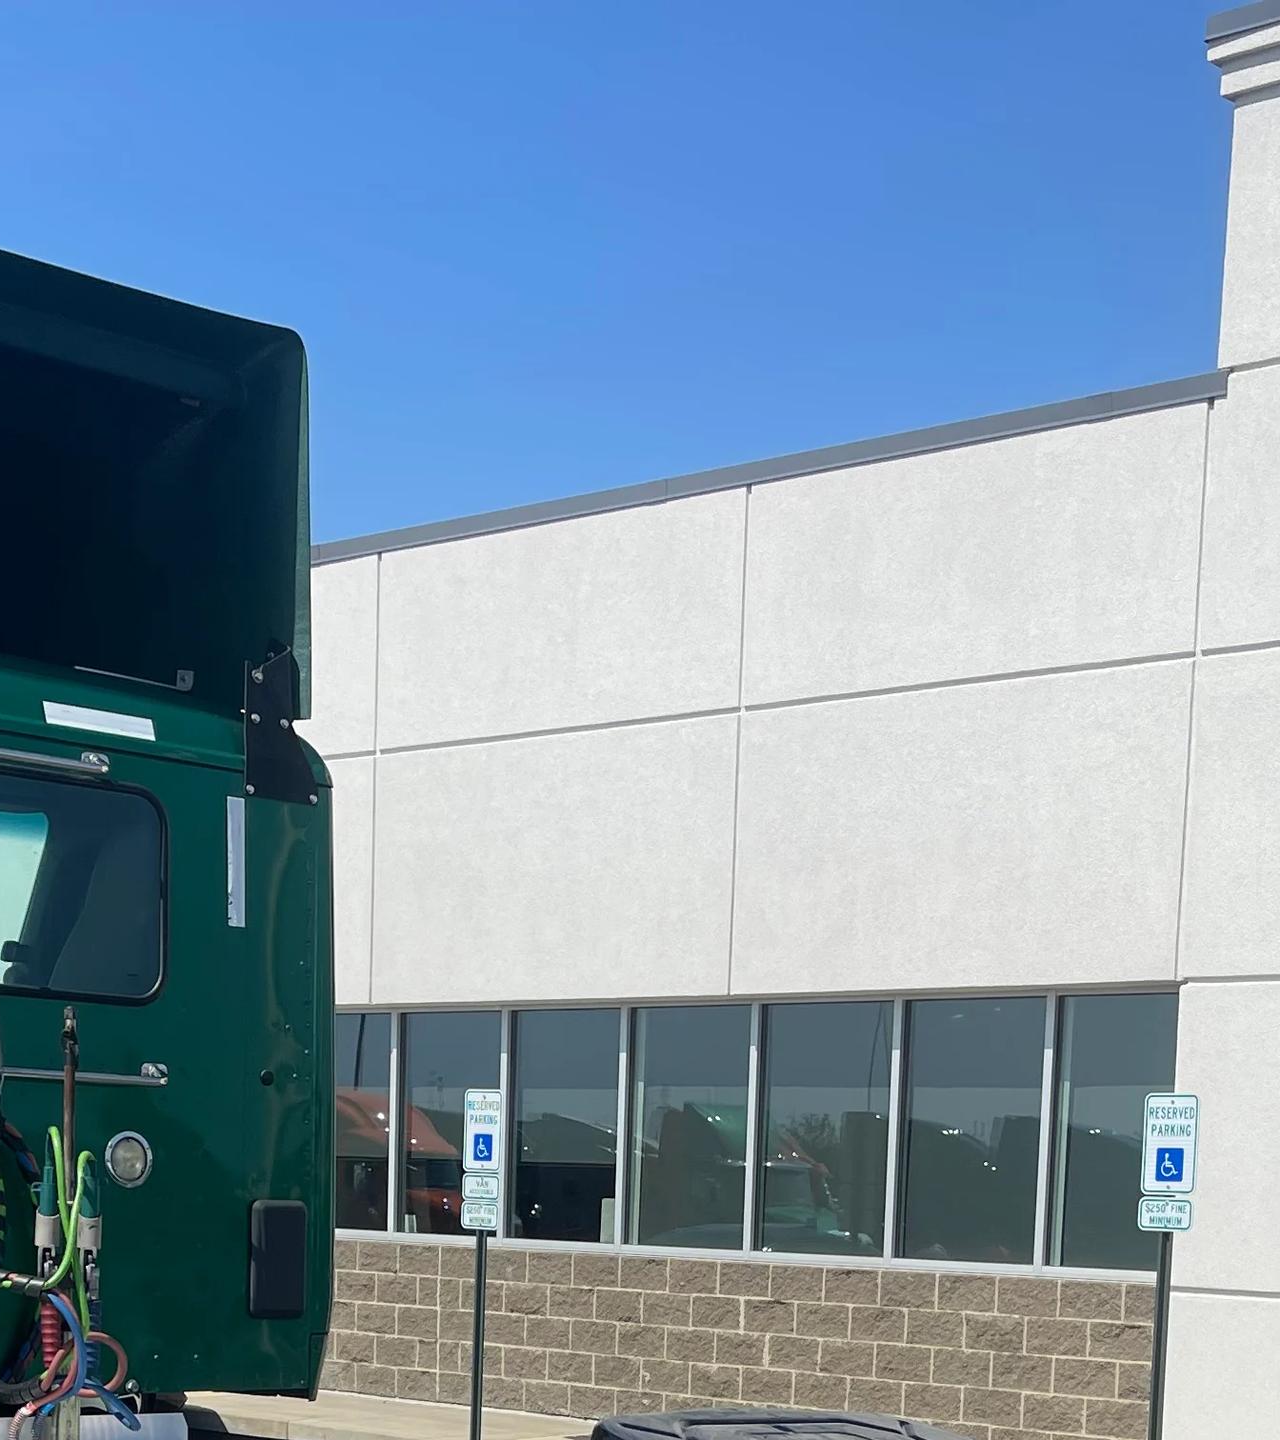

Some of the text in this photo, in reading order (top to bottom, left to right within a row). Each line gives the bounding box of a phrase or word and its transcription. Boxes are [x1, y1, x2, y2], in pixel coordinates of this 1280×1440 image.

[1149, 1106, 1195, 1120] RESERVED
[1150, 1123, 1192, 1137] PARKING
[1144, 1202, 1187, 1214] $250 FINE
[1149, 1215, 1183, 1226] MINIMUM
